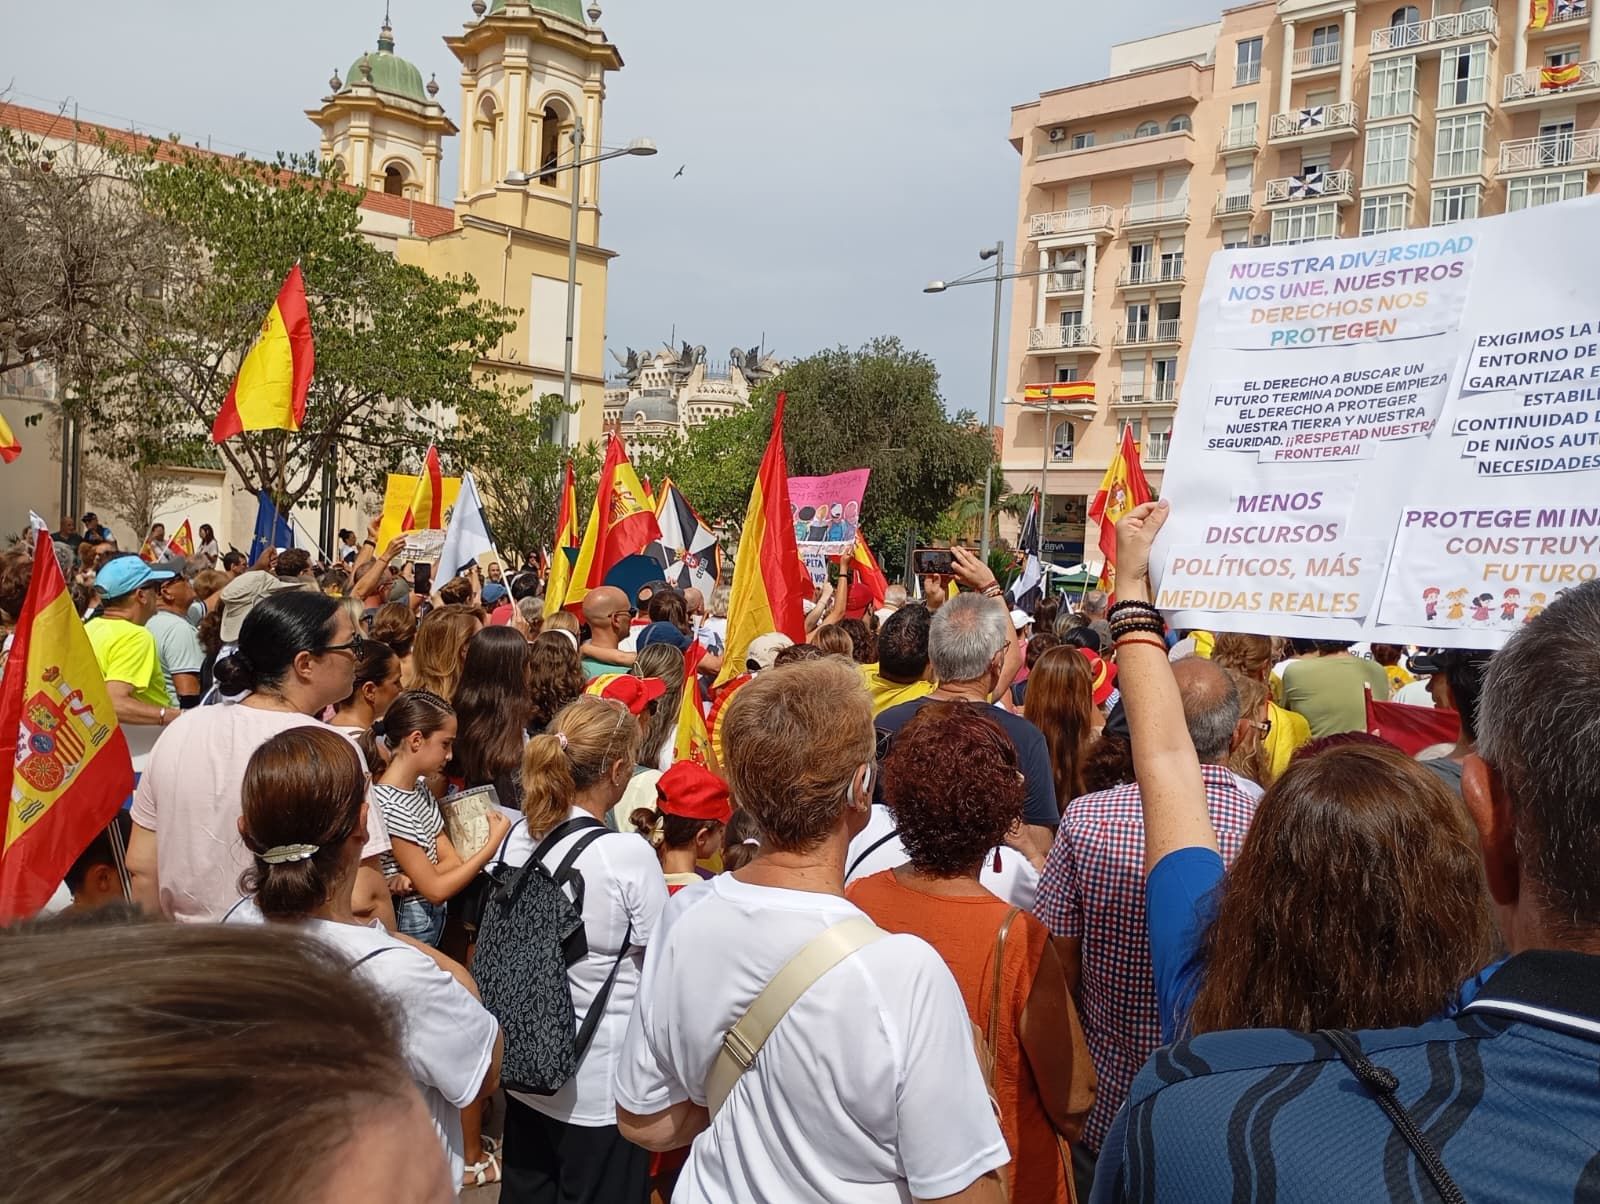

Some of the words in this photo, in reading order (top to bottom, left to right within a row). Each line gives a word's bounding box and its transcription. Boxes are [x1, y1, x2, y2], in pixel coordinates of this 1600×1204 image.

[1229, 255, 1335, 280] NUESTRA
[1227, 284, 1275, 302] NOS
[1279, 279, 1329, 298] UNE,
[1333, 261, 1464, 294] NUESTROS
[1250, 297, 1373, 324] DERECHOS
[1377, 291, 1429, 313] NOS
[1270, 318, 1398, 346] PROTEGEN
[1477, 326, 1565, 348] EXIGIMOS
[1570, 322, 1592, 338] LA
[1478, 348, 1569, 368] ENTORNO
[1574, 343, 1597, 359] DE
[1214, 394, 1269, 406] FUTURO
[1271, 388, 1332, 403] TERMINA
[1334, 383, 1383, 398] DONDE
[1385, 373, 1448, 393] EMPIEZA
[1243, 380, 1261, 392] EL
[1263, 375, 1329, 391] DERECHO
[1329, 374, 1341, 385] A
[1342, 366, 1401, 383] BUSCAR
[1403, 363, 1425, 377] UN
[1469, 367, 1585, 389] GARANTIZAR
[1239, 410, 1256, 420] EL
[1257, 403, 1323, 419] DERECHO
[1324, 402, 1335, 413] A
[1337, 393, 1418, 412] PROTEGER
[1226, 420, 1288, 434] NUESTRA
[1290, 416, 1342, 431] TIERRA
[1344, 415, 1356, 426] Y
[1357, 407, 1426, 425] NUESTRA
[1457, 411, 1588, 432] CONTINUIDAD
[1207, 436, 1284, 449] SEGURIDAD.
[1285, 427, 1369, 448] ¡¡RESPETAD
[1369, 418, 1437, 439] NUESTRA
[1466, 440, 1490, 452] DE
[1495, 434, 1555, 451] NIÑOS
[1559, 432, 1600, 449] AUT
[1274, 444, 1361, 461] FRONTERA!!
[1477, 454, 1600, 475] NECESIDADES
[1236, 491, 1323, 514] MENOS
[1404, 509, 1532, 528] PROTEGE
[1536, 508, 1566, 528] MI
[1569, 508, 1600, 528] IN
[1205, 523, 1338, 545] DISCURSOS
[1445, 536, 1600, 555] CONSTRUY
[1171, 553, 1297, 580] POLÍTICOS,
[1305, 552, 1361, 577] MÁS
[1482, 563, 1597, 583] FUTURO
[1160, 590, 1263, 611] MEDIDAS
[1268, 591, 1361, 613] REALES
